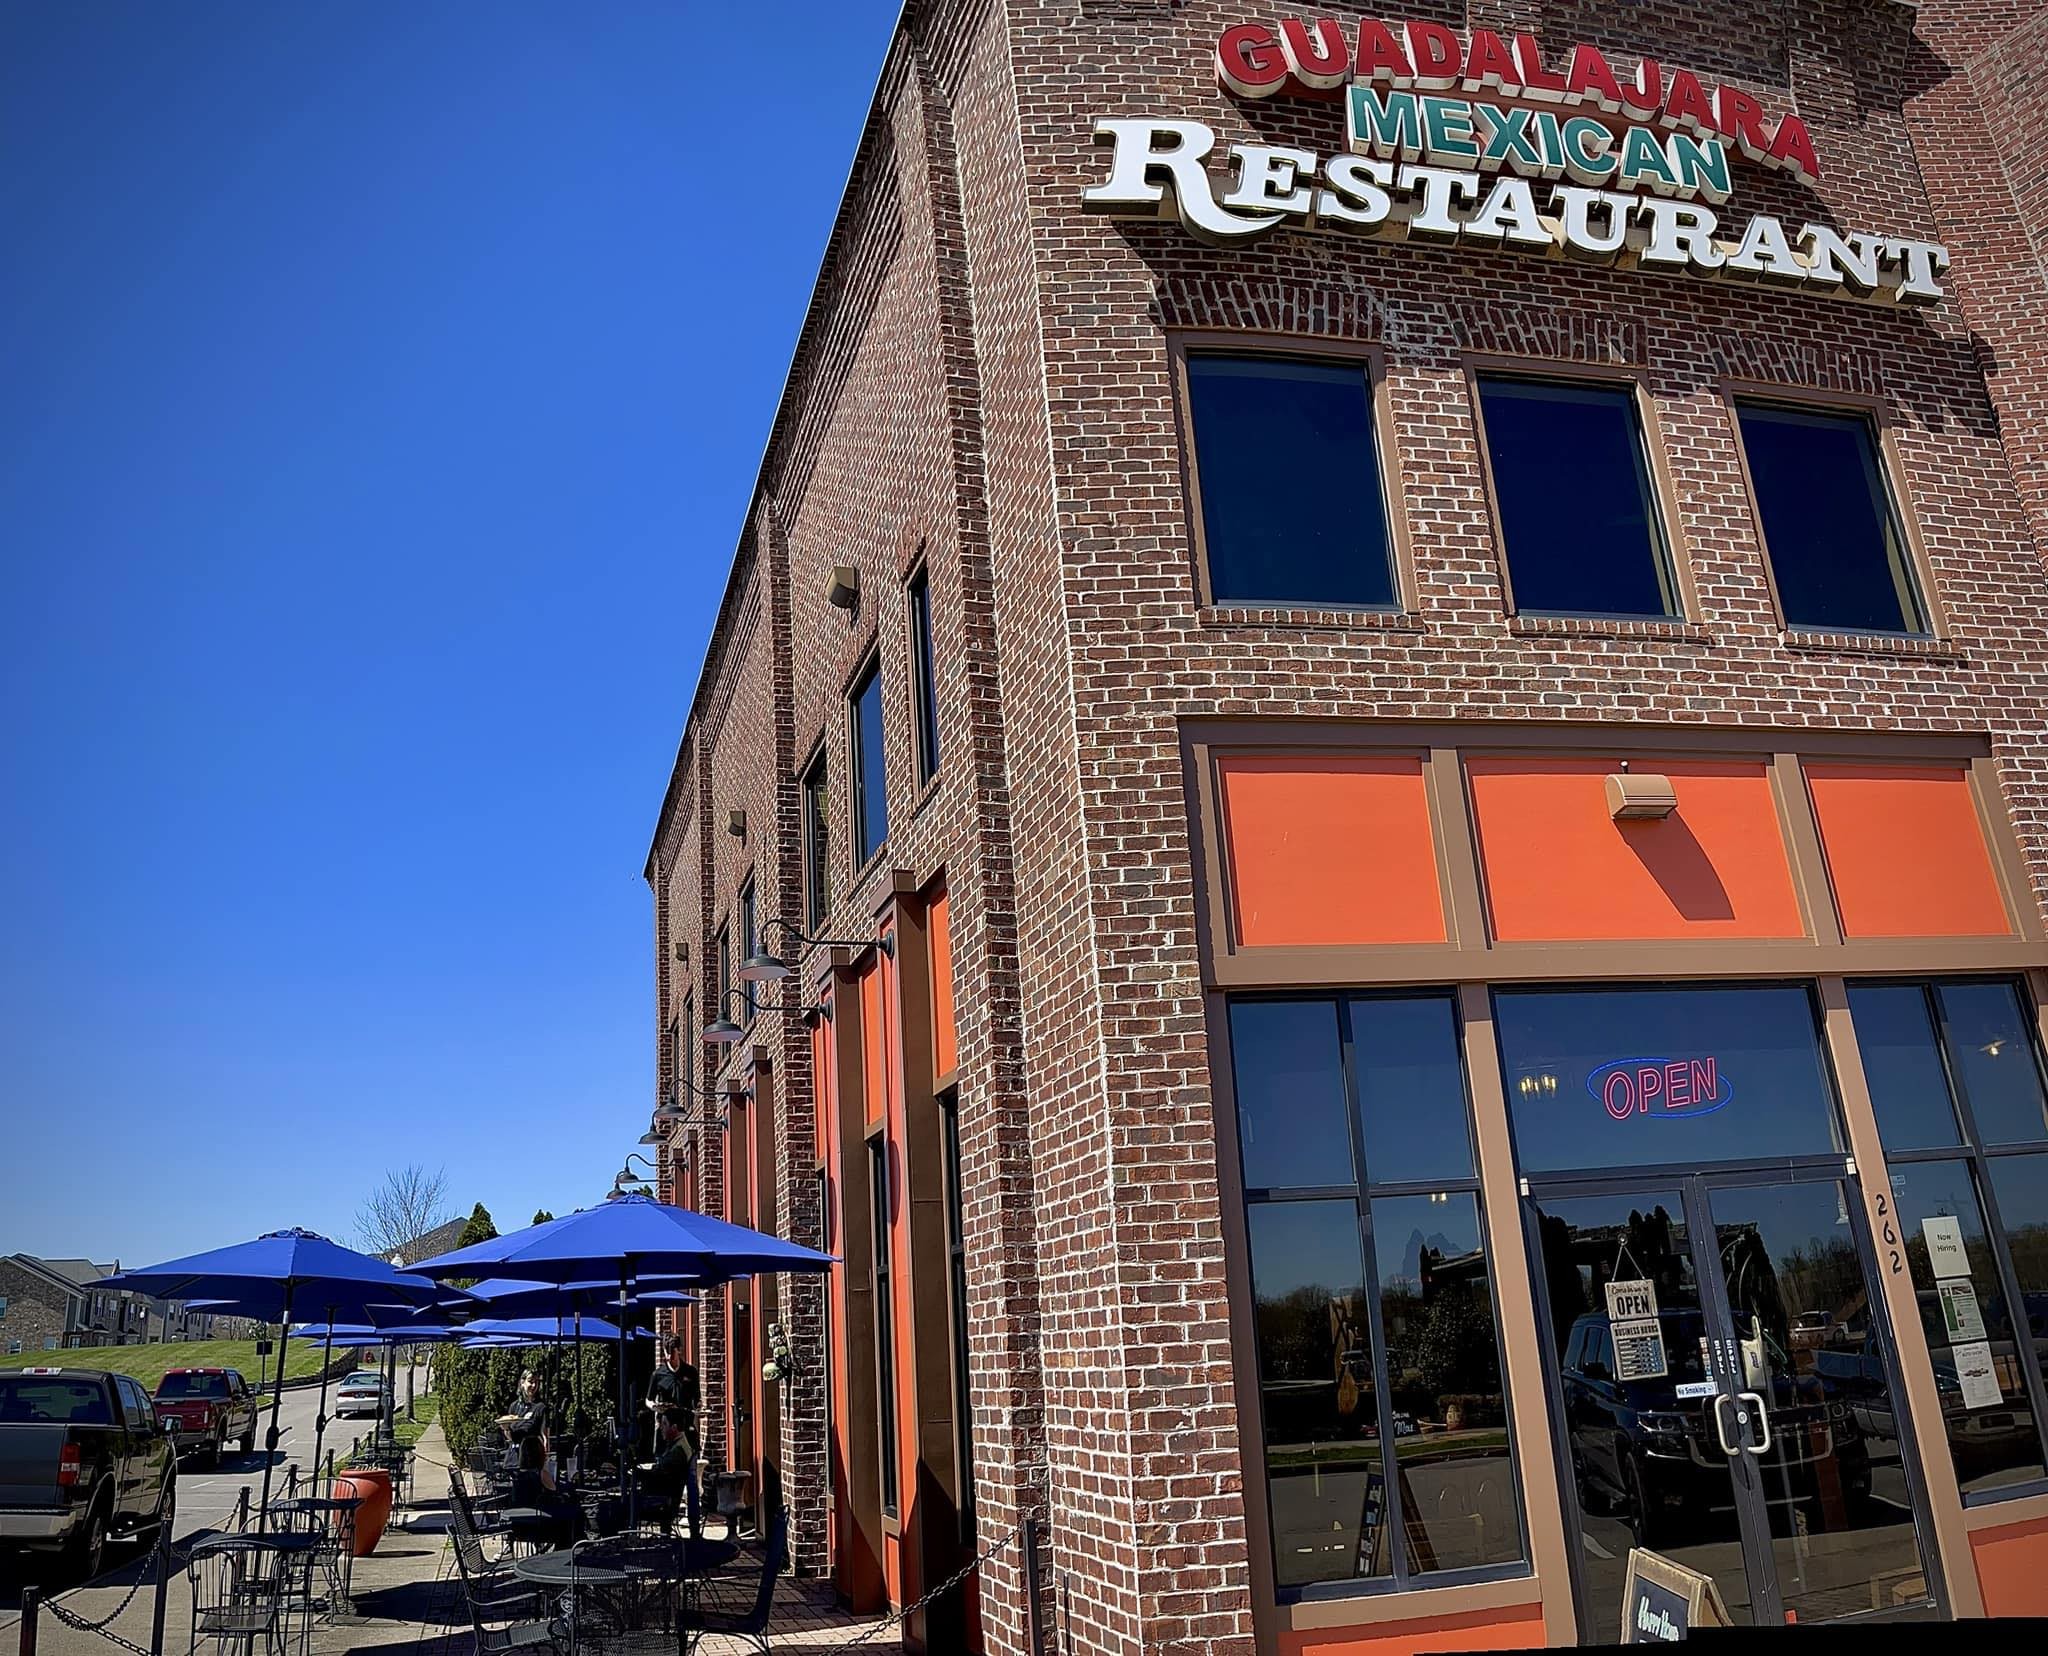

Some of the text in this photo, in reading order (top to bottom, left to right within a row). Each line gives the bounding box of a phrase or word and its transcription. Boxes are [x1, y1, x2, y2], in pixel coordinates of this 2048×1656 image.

[1215, 18, 1822, 182] GUADALAJARA
[1346, 85, 1735, 202] MEXICAN
[1083, 117, 1951, 306] RESTAURANT
[1604, 1056, 1717, 1120] OPEN
[1937, 1233, 1951, 1241] Now
[1937, 1244, 1957, 1253] Hiring
[1616, 1295, 1650, 1316] OPEN
[1615, 1324, 1659, 1337] BUSINESS HOURS
[1685, 1386, 1707, 1396] Smoking
